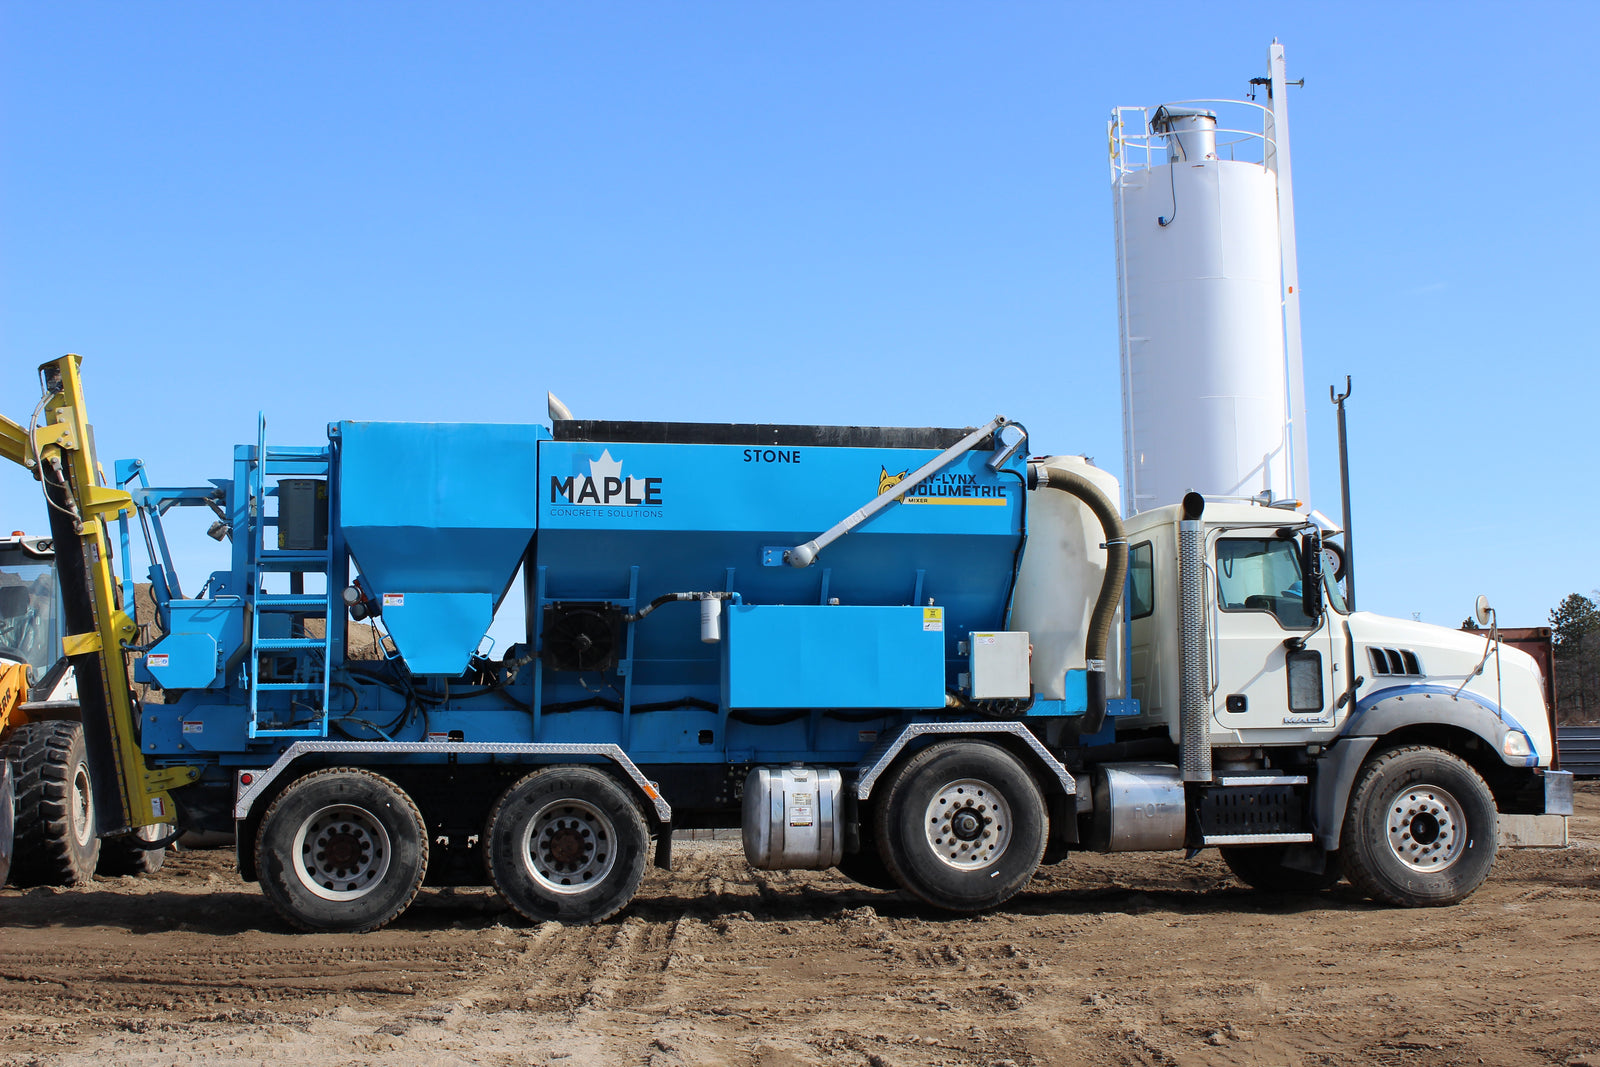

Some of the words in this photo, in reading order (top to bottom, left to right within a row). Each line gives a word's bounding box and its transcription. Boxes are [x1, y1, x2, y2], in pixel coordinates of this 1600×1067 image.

[743, 449, 801, 464] STONE
[550, 475, 663, 505] MAPLE
[908, 485, 1006, 497] VOLUMETRIC
[550, 508, 604, 517] CONCRETE
[607, 509, 664, 518] SOLUTIONS
